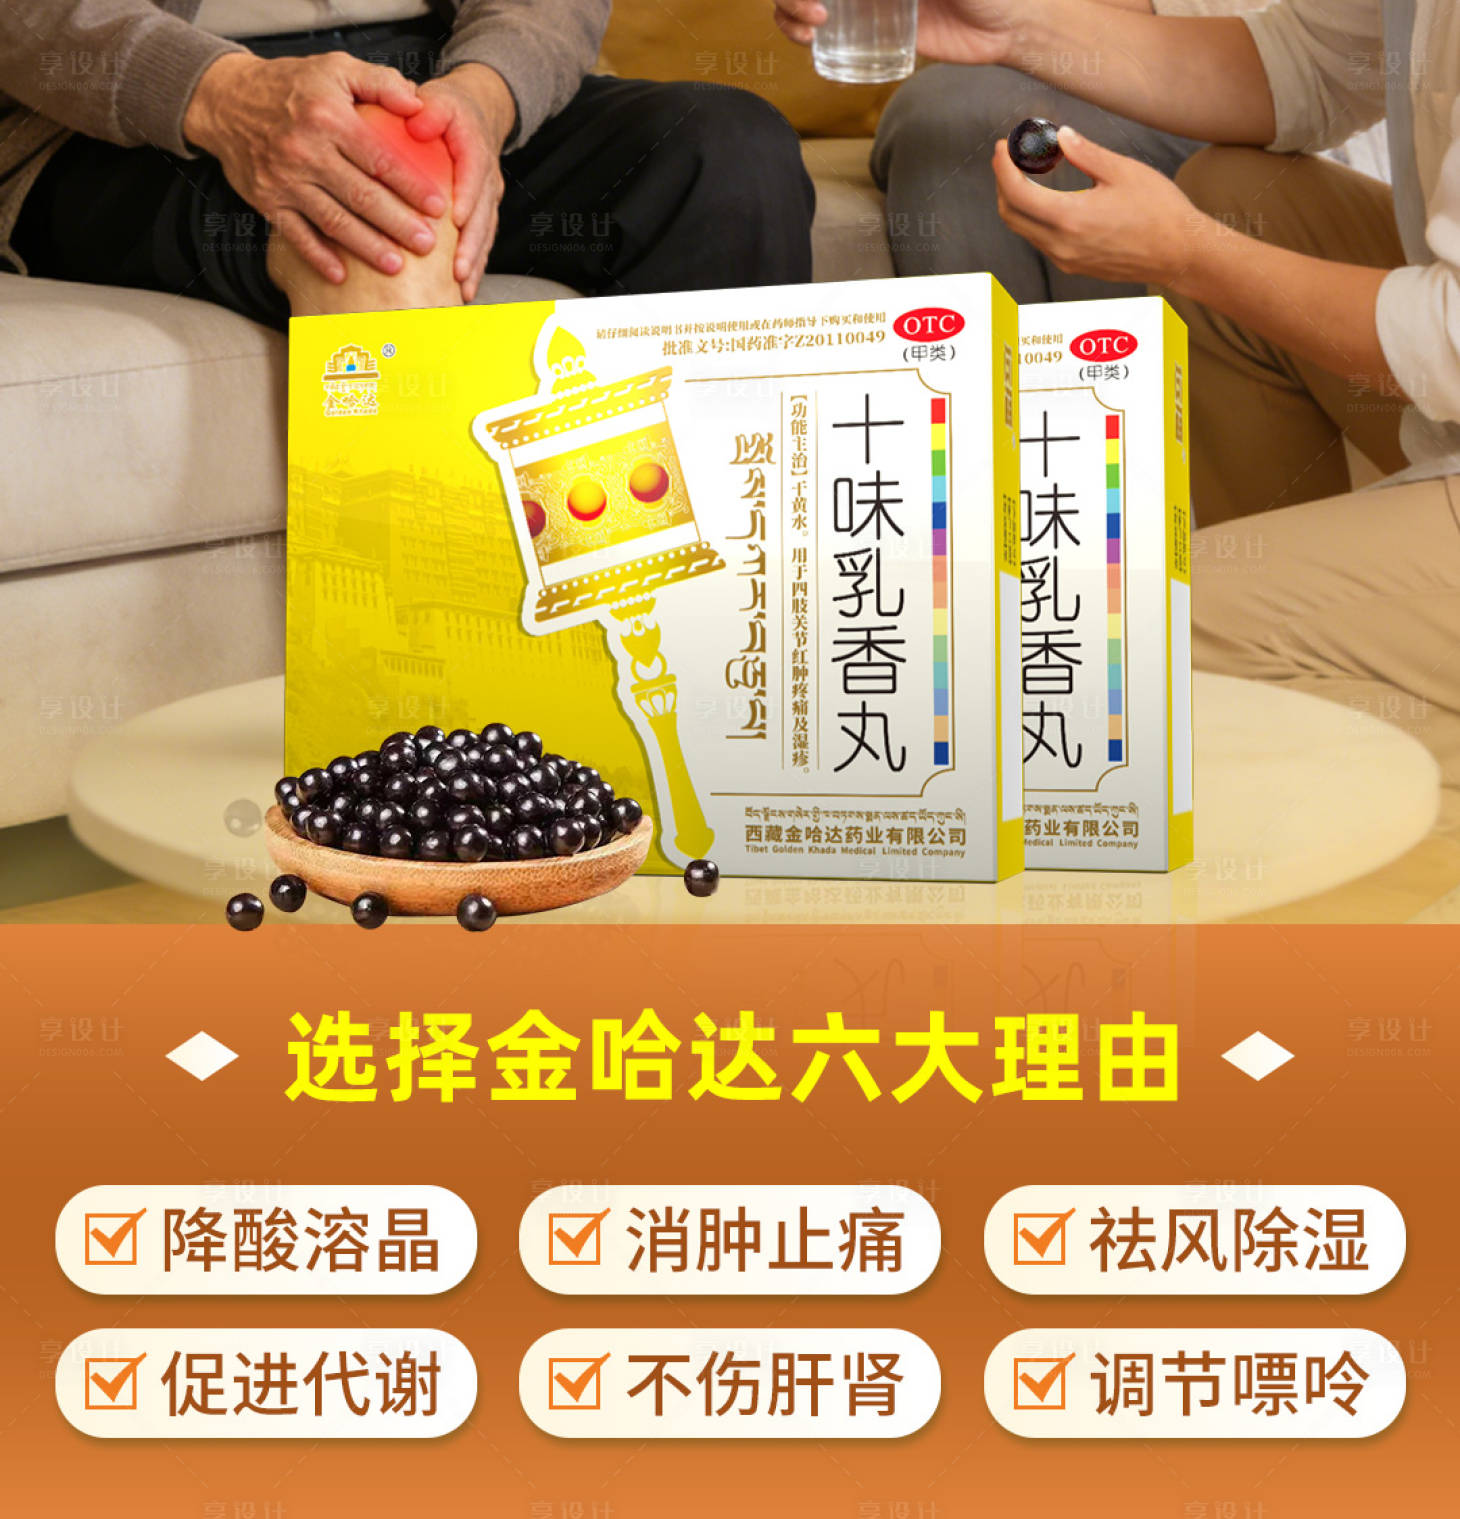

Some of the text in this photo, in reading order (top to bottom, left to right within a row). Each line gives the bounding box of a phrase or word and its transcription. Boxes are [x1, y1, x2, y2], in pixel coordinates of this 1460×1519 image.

[903, 315, 957, 336] OTC
[661, 330, 886, 357] 批准文号:国药准字Z20110049
[902, 343, 956, 362] (甲类)
[1078, 335, 1132, 356] OTC
[1078, 365, 1130, 381] (甲类)
[831, 394, 907, 772] 十味乳香丸
[745, 824, 966, 846] 西藏金哈达药业有限公司
[1024, 819, 1139, 838] 药业有限公司
[745, 845, 966, 859] Tibet Golden Khada Medical Limited Company
[1059, 838, 1093, 848] Limited
[1096, 838, 1139, 850] Company
[285, 1008, 1178, 1103] 选择金哈达六大理由
[162, 1206, 440, 1273] 降酸溶晶
[627, 1206, 904, 1273] 消肿止痛
[1090, 1206, 1369, 1273] 祛风除湿
[161, 1351, 441, 1417] 促进代谢
[627, 1351, 903, 1417] 不伤肝肾
[1090, 1350, 1369, 1417] 调节嘌呤
